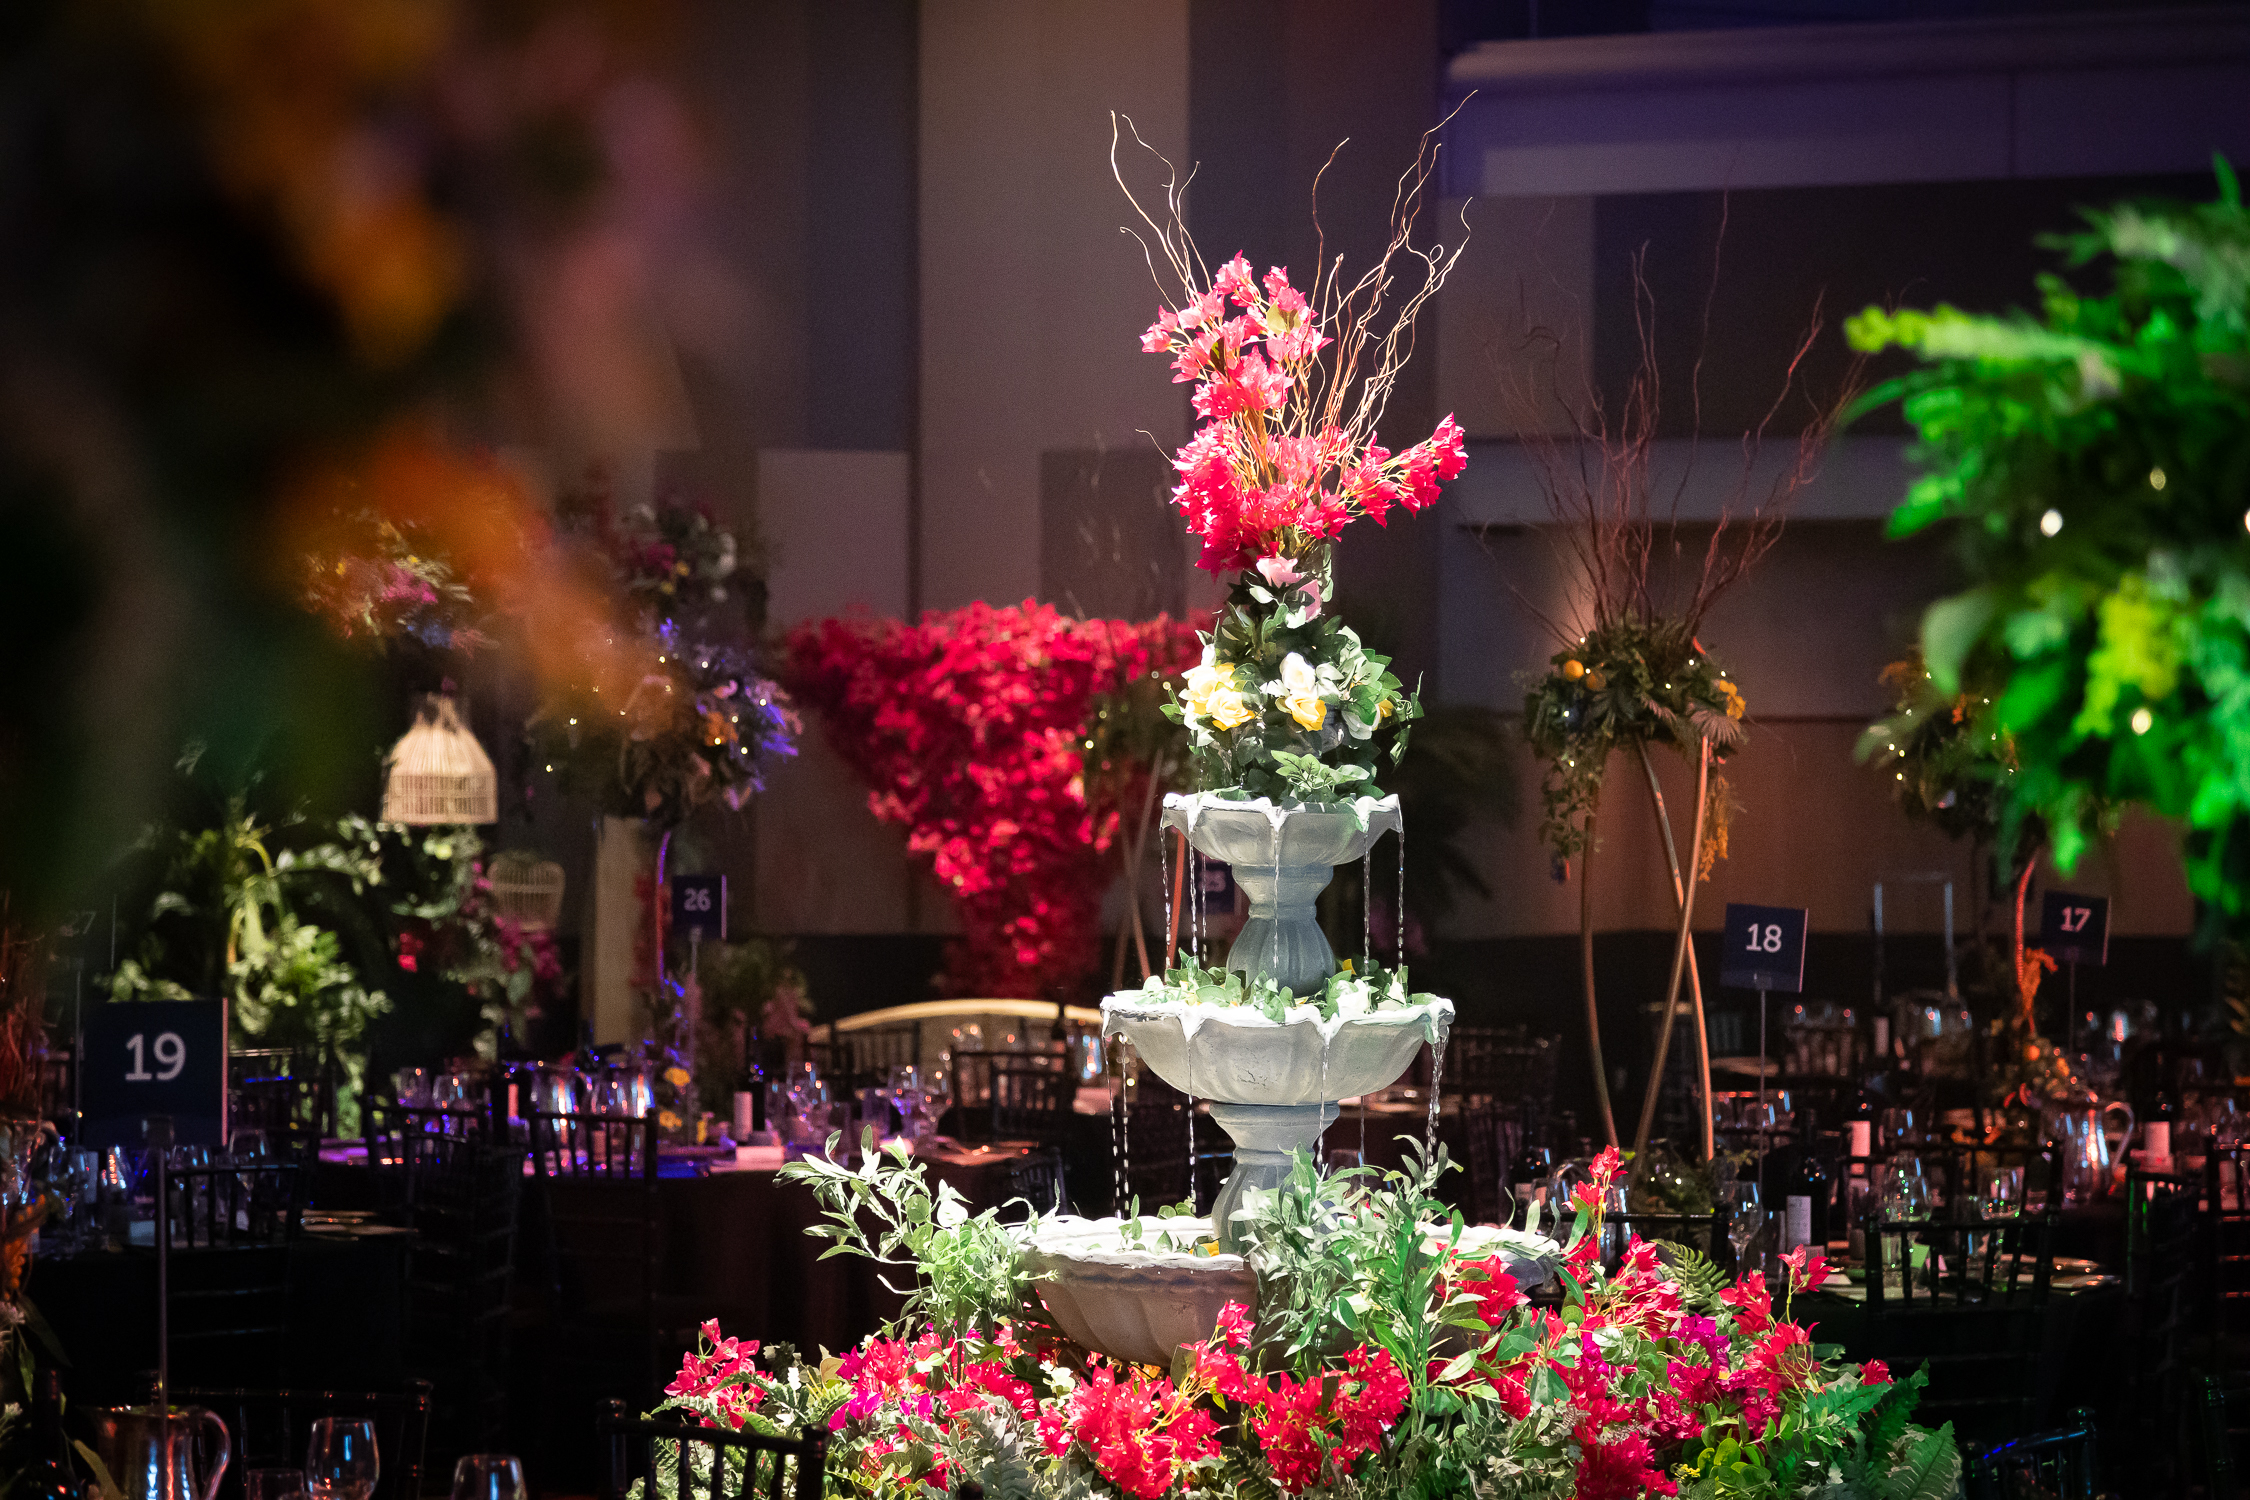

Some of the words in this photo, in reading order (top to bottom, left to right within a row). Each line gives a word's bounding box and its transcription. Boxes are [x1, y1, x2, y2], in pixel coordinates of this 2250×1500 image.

[683, 887, 711, 912] 26
[2059, 906, 2092, 933] 17
[1745, 923, 1782, 954] 18
[124, 1031, 186, 1082] 19
